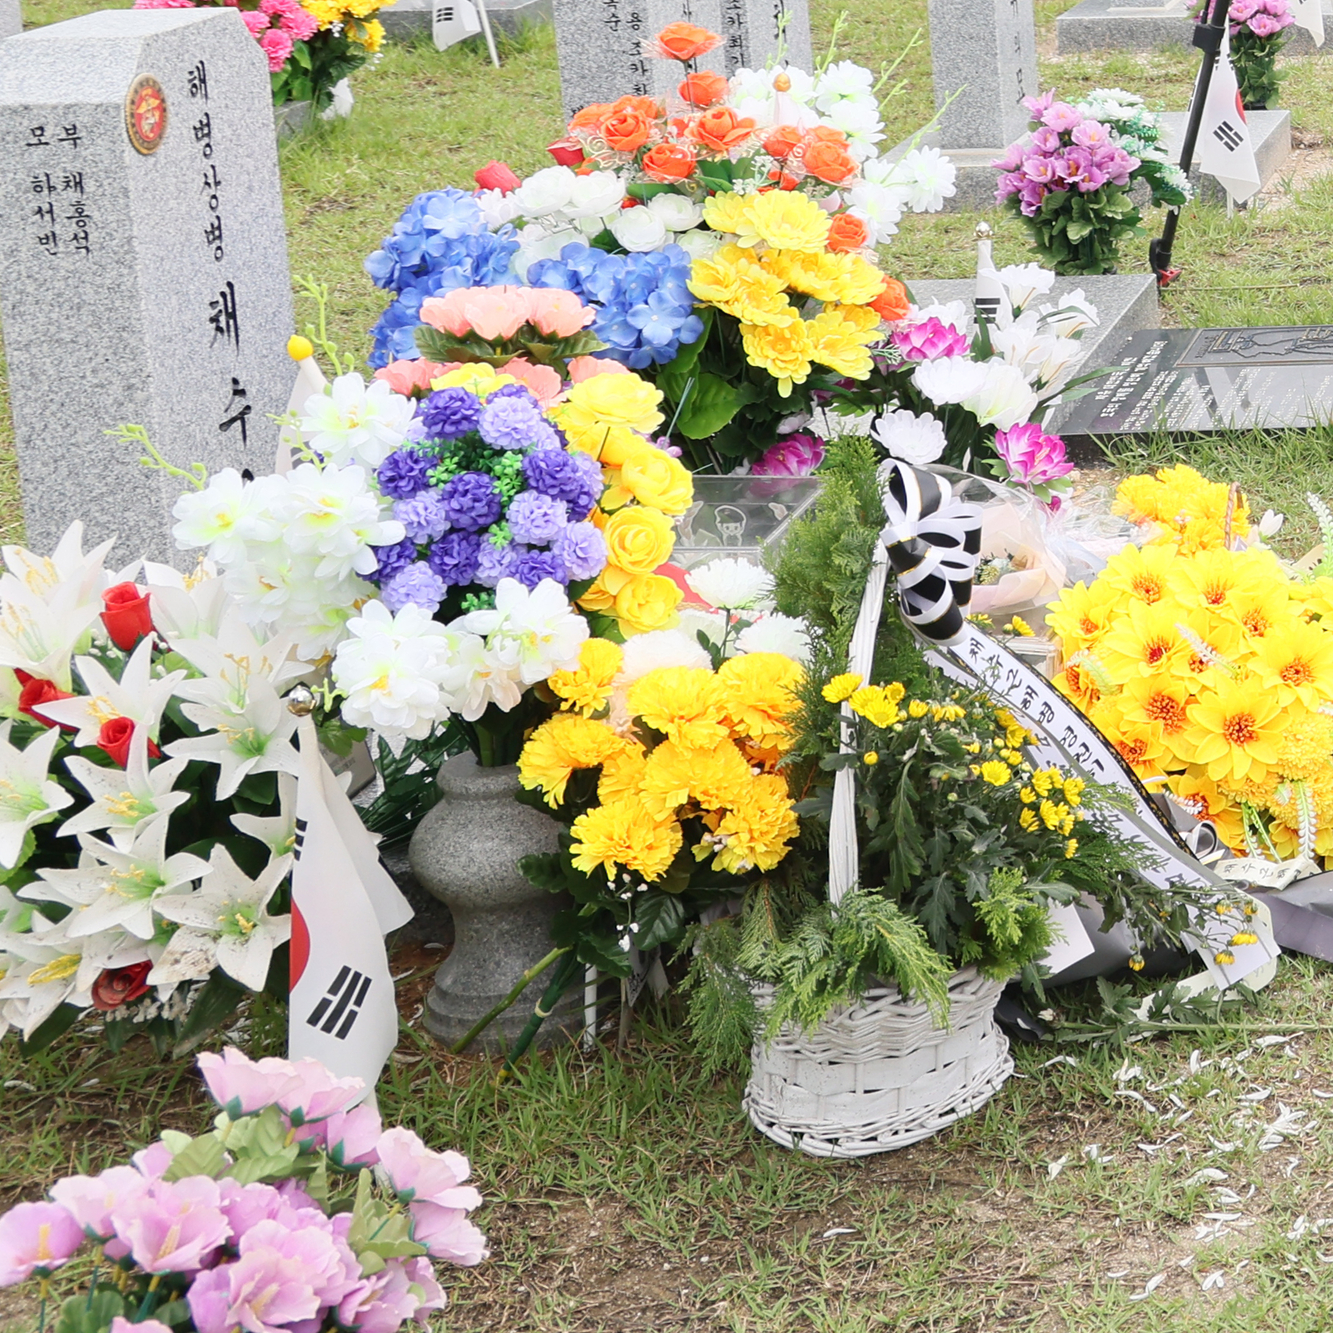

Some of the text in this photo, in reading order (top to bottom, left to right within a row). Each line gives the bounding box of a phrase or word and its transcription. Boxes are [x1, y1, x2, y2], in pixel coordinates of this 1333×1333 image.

[24, 124, 59, 254] 모 하서빈
[57, 122, 91, 257] 부 채홍석
[186, 58, 226, 264] 해병상병
